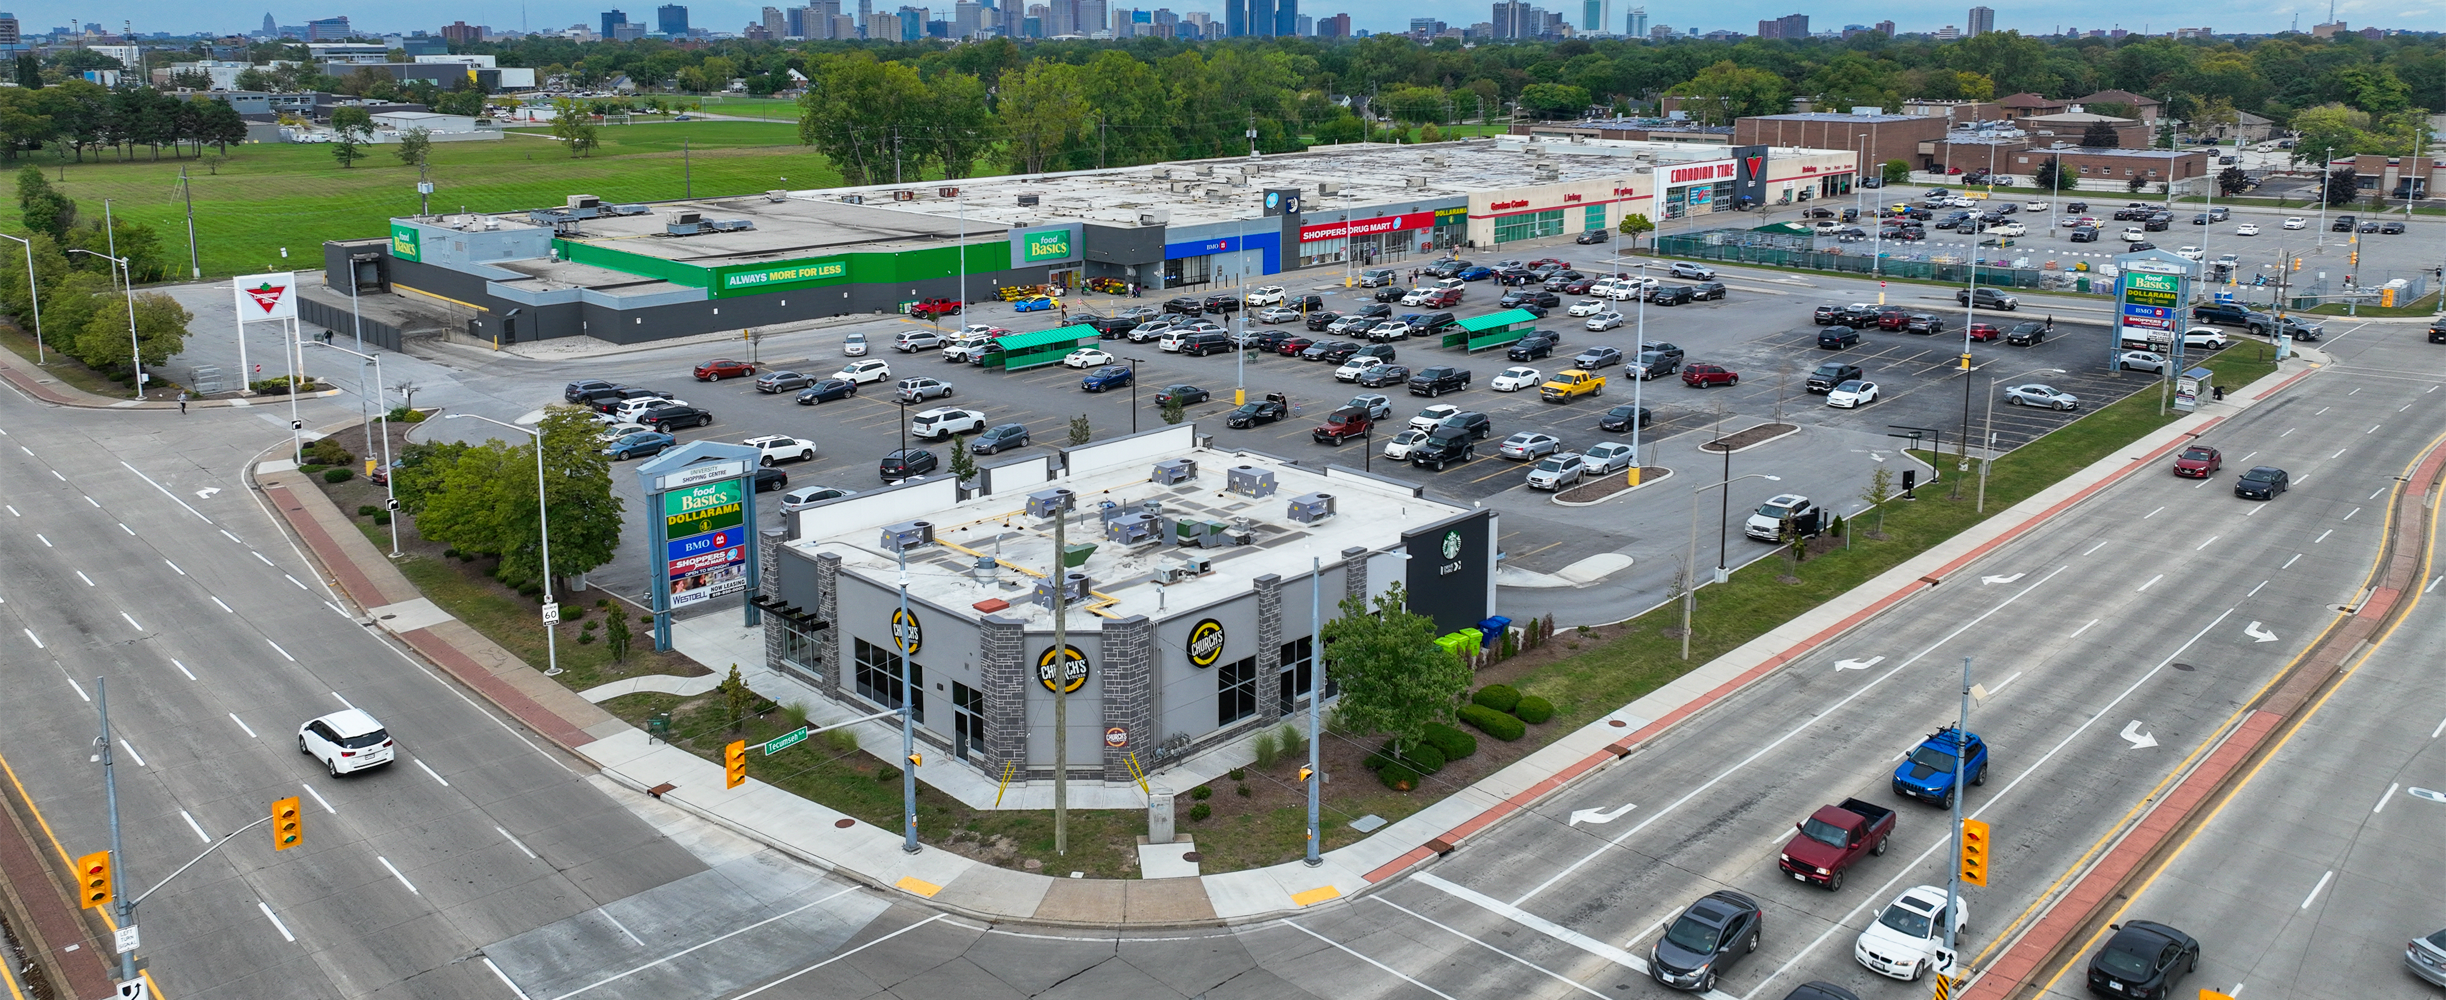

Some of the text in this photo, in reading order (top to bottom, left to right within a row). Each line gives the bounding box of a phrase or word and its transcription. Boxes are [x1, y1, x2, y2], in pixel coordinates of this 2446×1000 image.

[1670, 164, 1734, 183] CANADIAN TIRE
[1435, 207, 1468, 217] DOLLARAMA
[1302, 222, 1391, 240] SHOPPERS DRUG MART
[1040, 235, 1058, 244] food
[730, 265, 842, 285] ALWAYS MORE FOR LESS
[2128, 290, 2176, 299] DOLLARAMA
[690, 466, 718, 475] UNIVERSITY
[682, 474, 706, 483] SHOPPING
[693, 485, 716, 497] food
[668, 503, 740, 525] DOLLARAMA
[686, 539, 710, 552] BMO
[676, 552, 726, 568] SHOPPERS
[724, 580, 745, 588] LEASING
[545, 610, 556, 619] 60
[1191, 630, 1223, 656] CHURCH'S
[769, 733, 798, 751] Tecumseh
